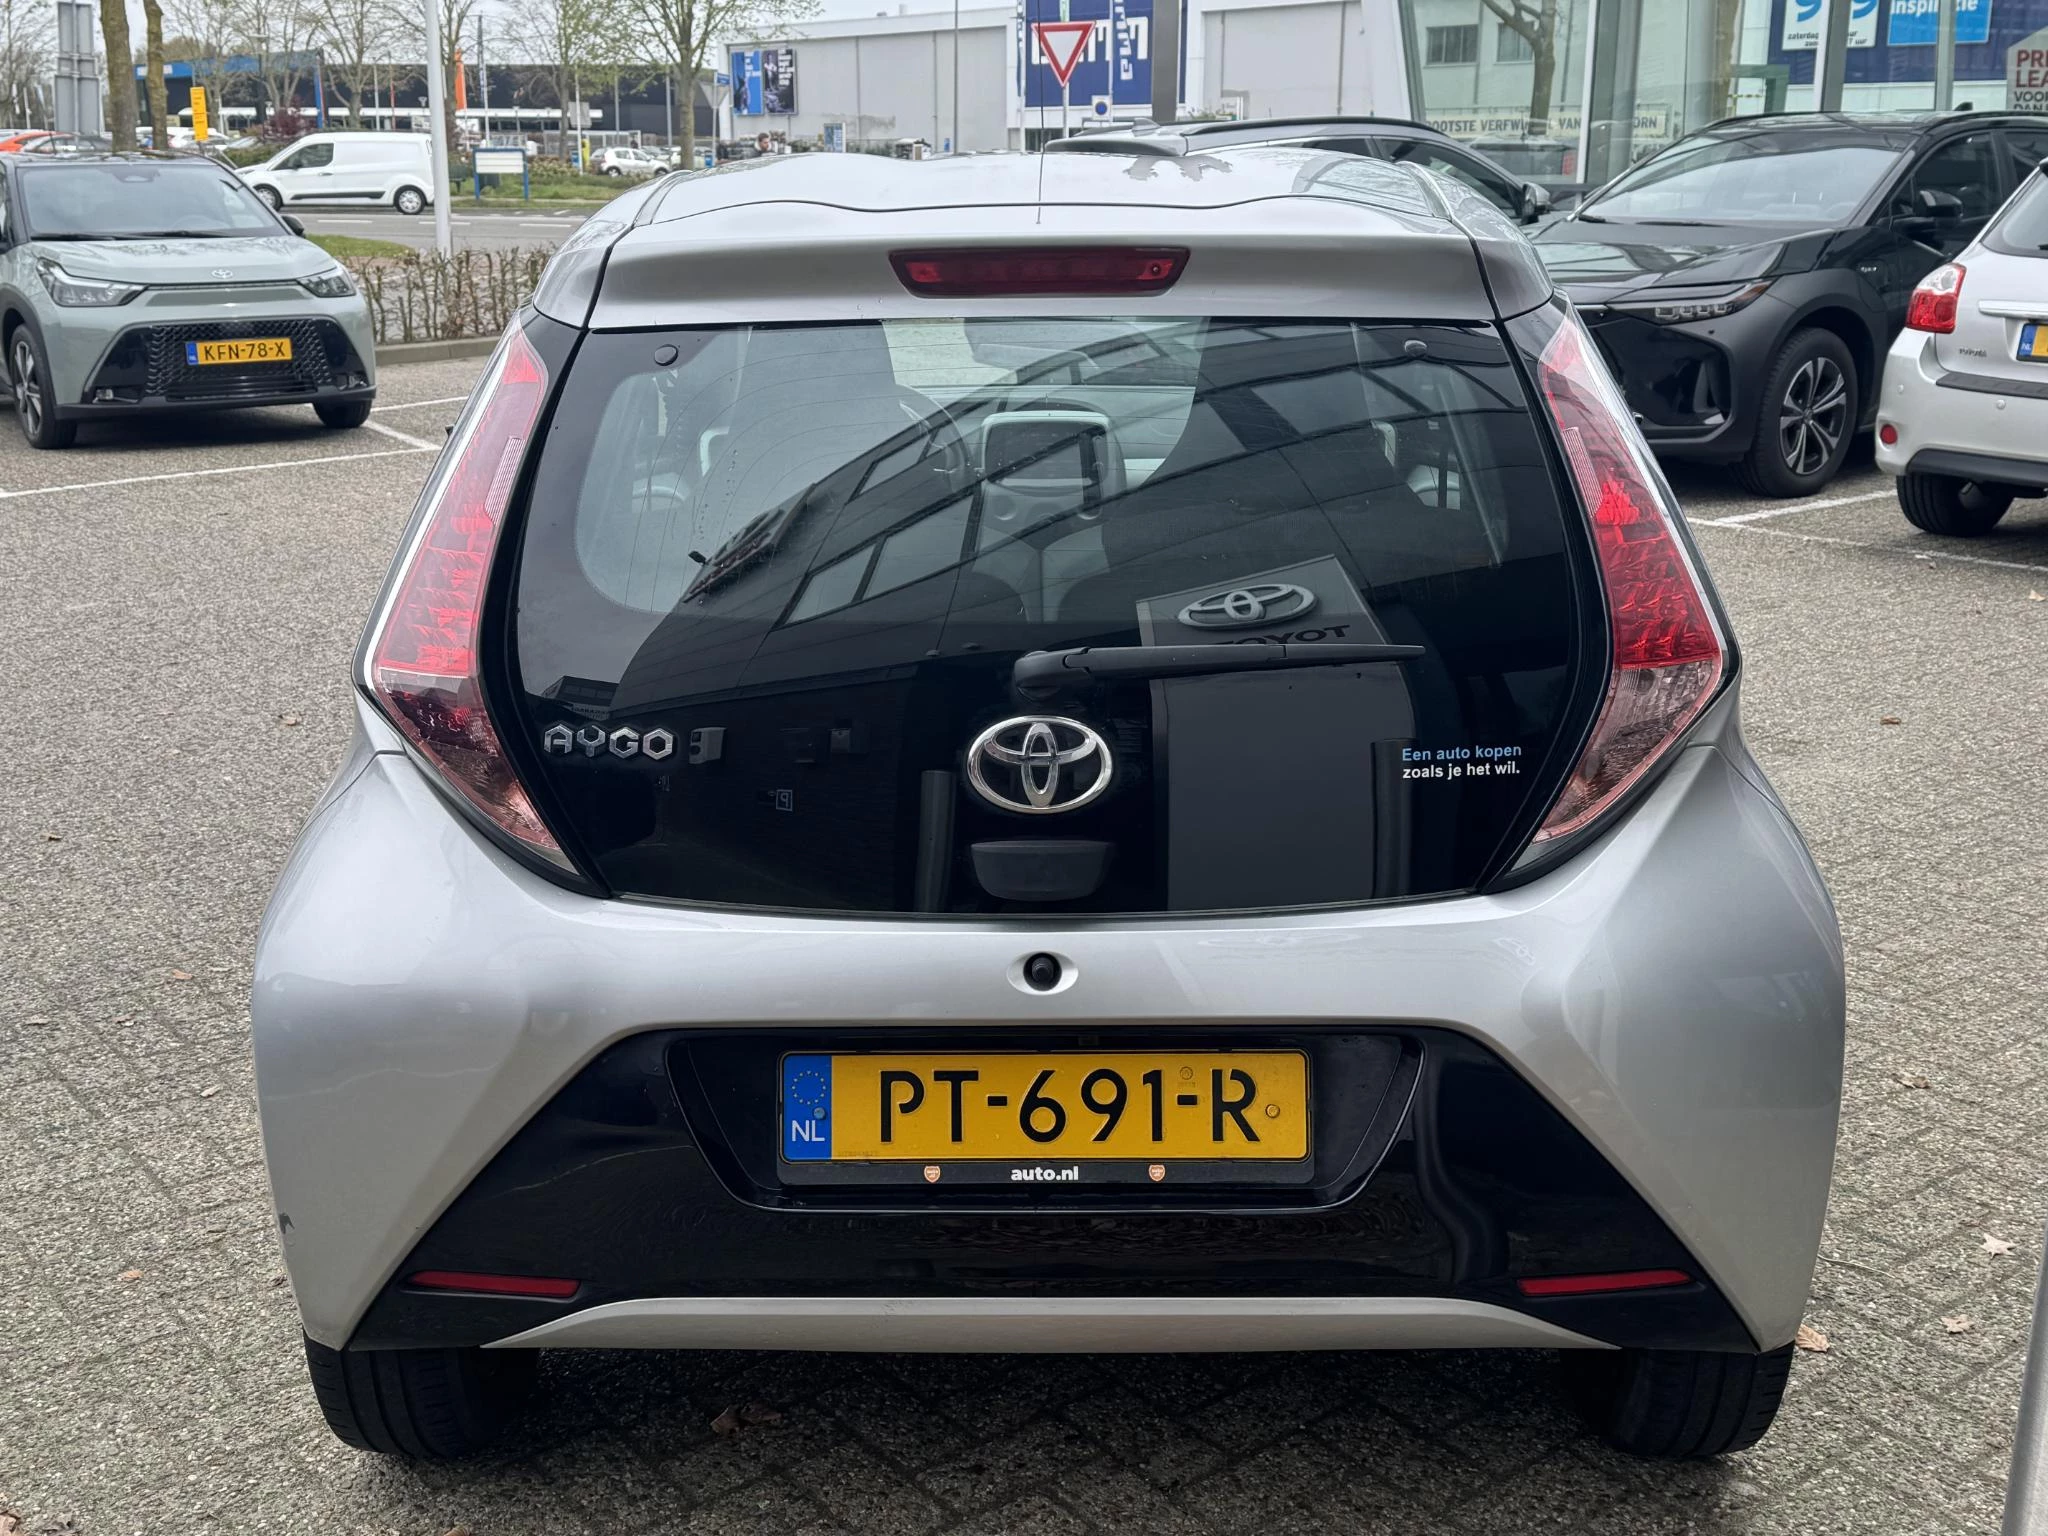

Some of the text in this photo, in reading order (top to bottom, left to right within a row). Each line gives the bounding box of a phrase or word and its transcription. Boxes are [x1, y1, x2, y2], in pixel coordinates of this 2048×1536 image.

[1889, 0, 1978, 18] inspirie
[1559, 117, 1581, 130] VAN
[203, 341, 286, 361] KFN-78-X
[543, 723, 674, 760] AYGO
[1402, 745, 1522, 761] Een auto kopen
[1402, 760, 1520, 780] zoals je het wil.
[880, 1068, 1261, 1144] PT-691-R
[791, 1119, 826, 1143] NL
[1010, 1165, 1079, 1181] auto.nl
